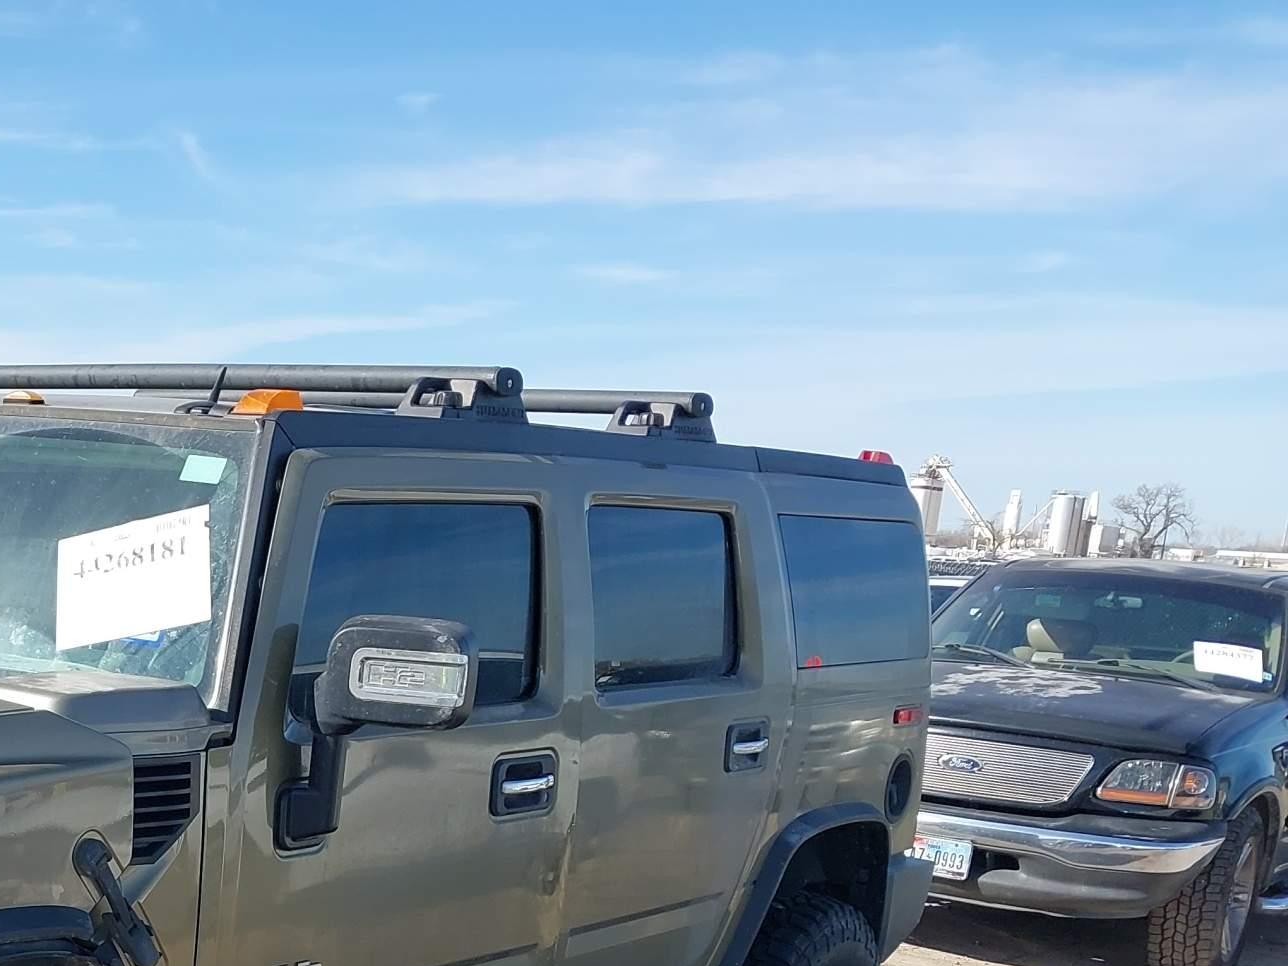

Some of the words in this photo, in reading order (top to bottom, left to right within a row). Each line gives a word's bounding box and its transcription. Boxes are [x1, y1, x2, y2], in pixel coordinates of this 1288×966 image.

[73, 535, 186, 579] 44268181
[367, 661, 425, 688] H2
[948, 756, 975, 770] Ford
[934, 850, 965, 871] 0993
